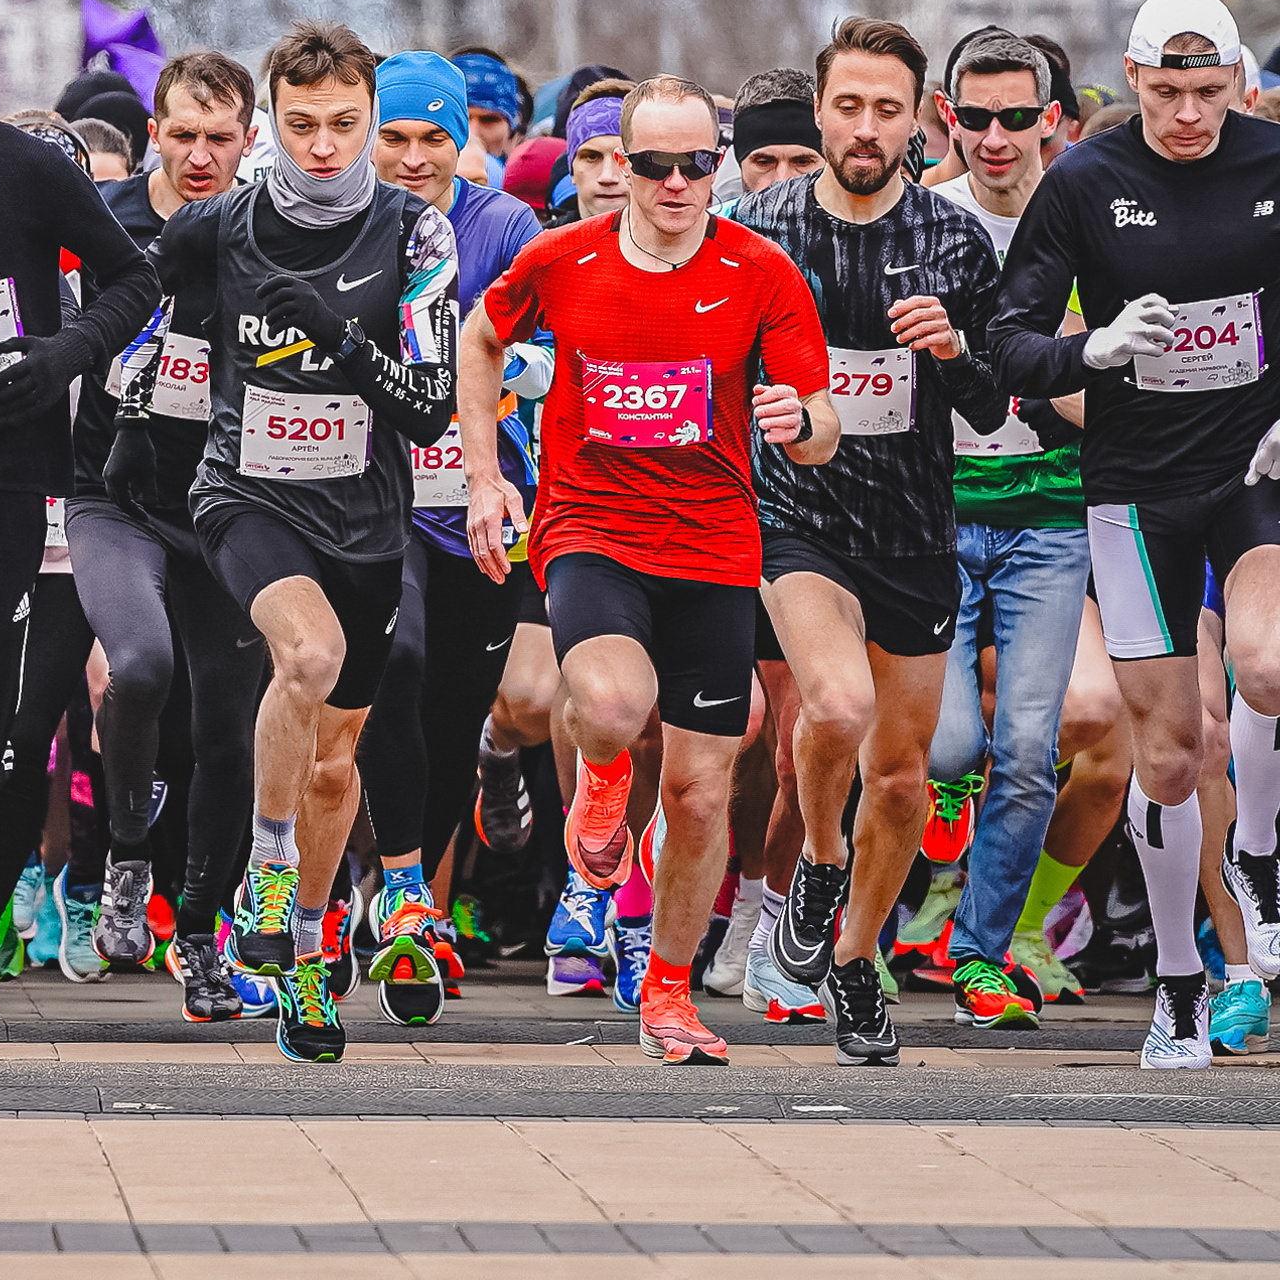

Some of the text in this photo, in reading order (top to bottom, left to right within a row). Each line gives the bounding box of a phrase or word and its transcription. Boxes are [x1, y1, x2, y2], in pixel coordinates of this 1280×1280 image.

[1113, 206, 1158, 228] Bite
[1153, 321, 1240, 352] 204
[1181, 352, 1214, 364] СЕРГЕЙ
[602, 384, 688, 410] 2367
[266, 415, 345, 441] 5201
[617, 412, 673, 421] КОНСТАНТИН
